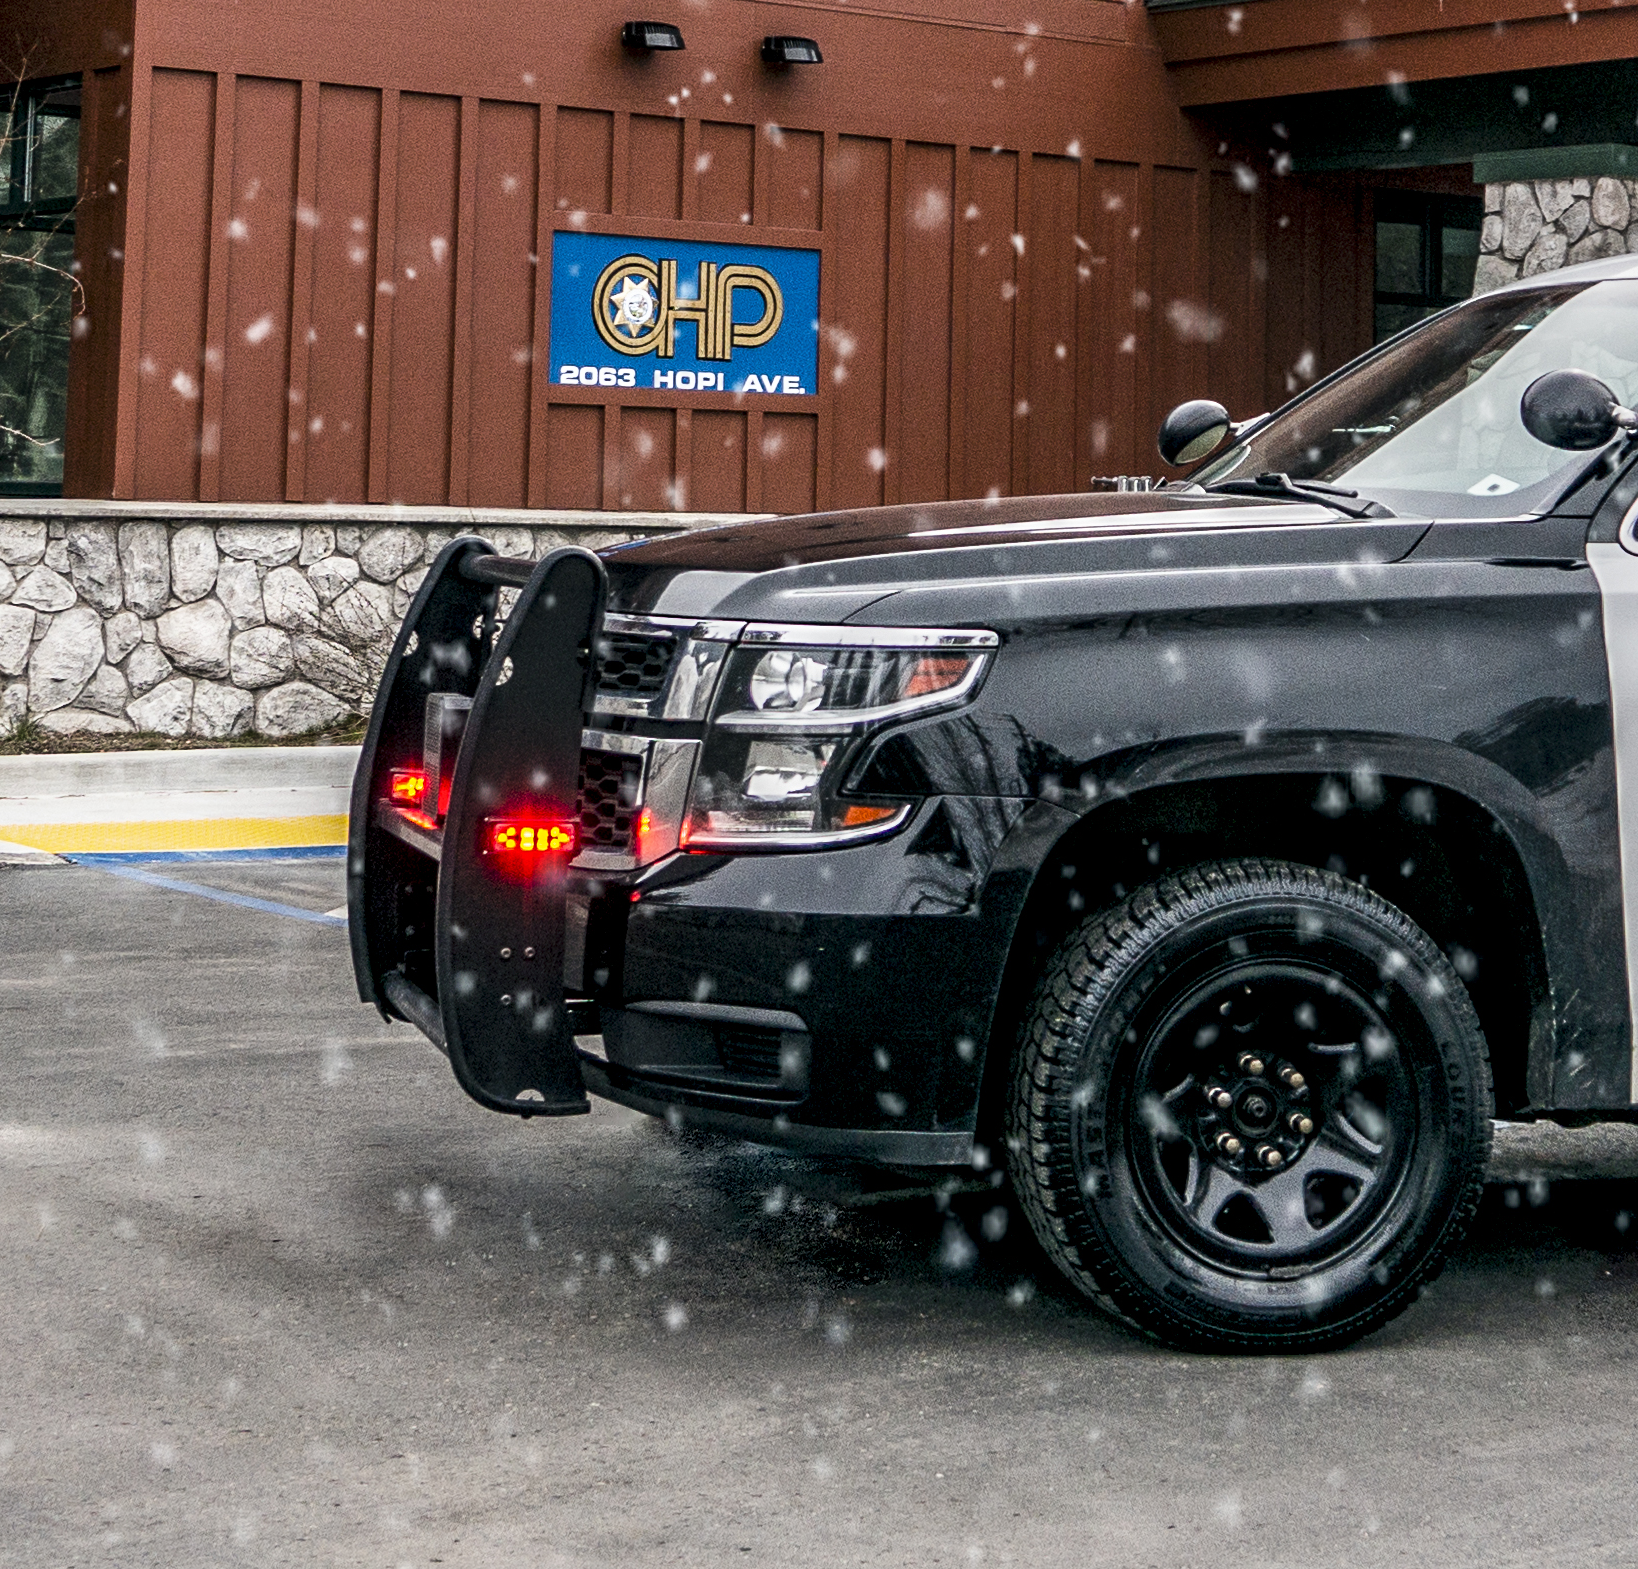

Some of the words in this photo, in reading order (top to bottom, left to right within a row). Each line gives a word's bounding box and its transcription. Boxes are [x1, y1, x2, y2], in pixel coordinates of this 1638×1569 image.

[592, 253, 784, 360] CHP
[560, 365, 636, 388] 2063
[654, 370, 724, 391] HOPI
[742, 375, 806, 395] AVE.
